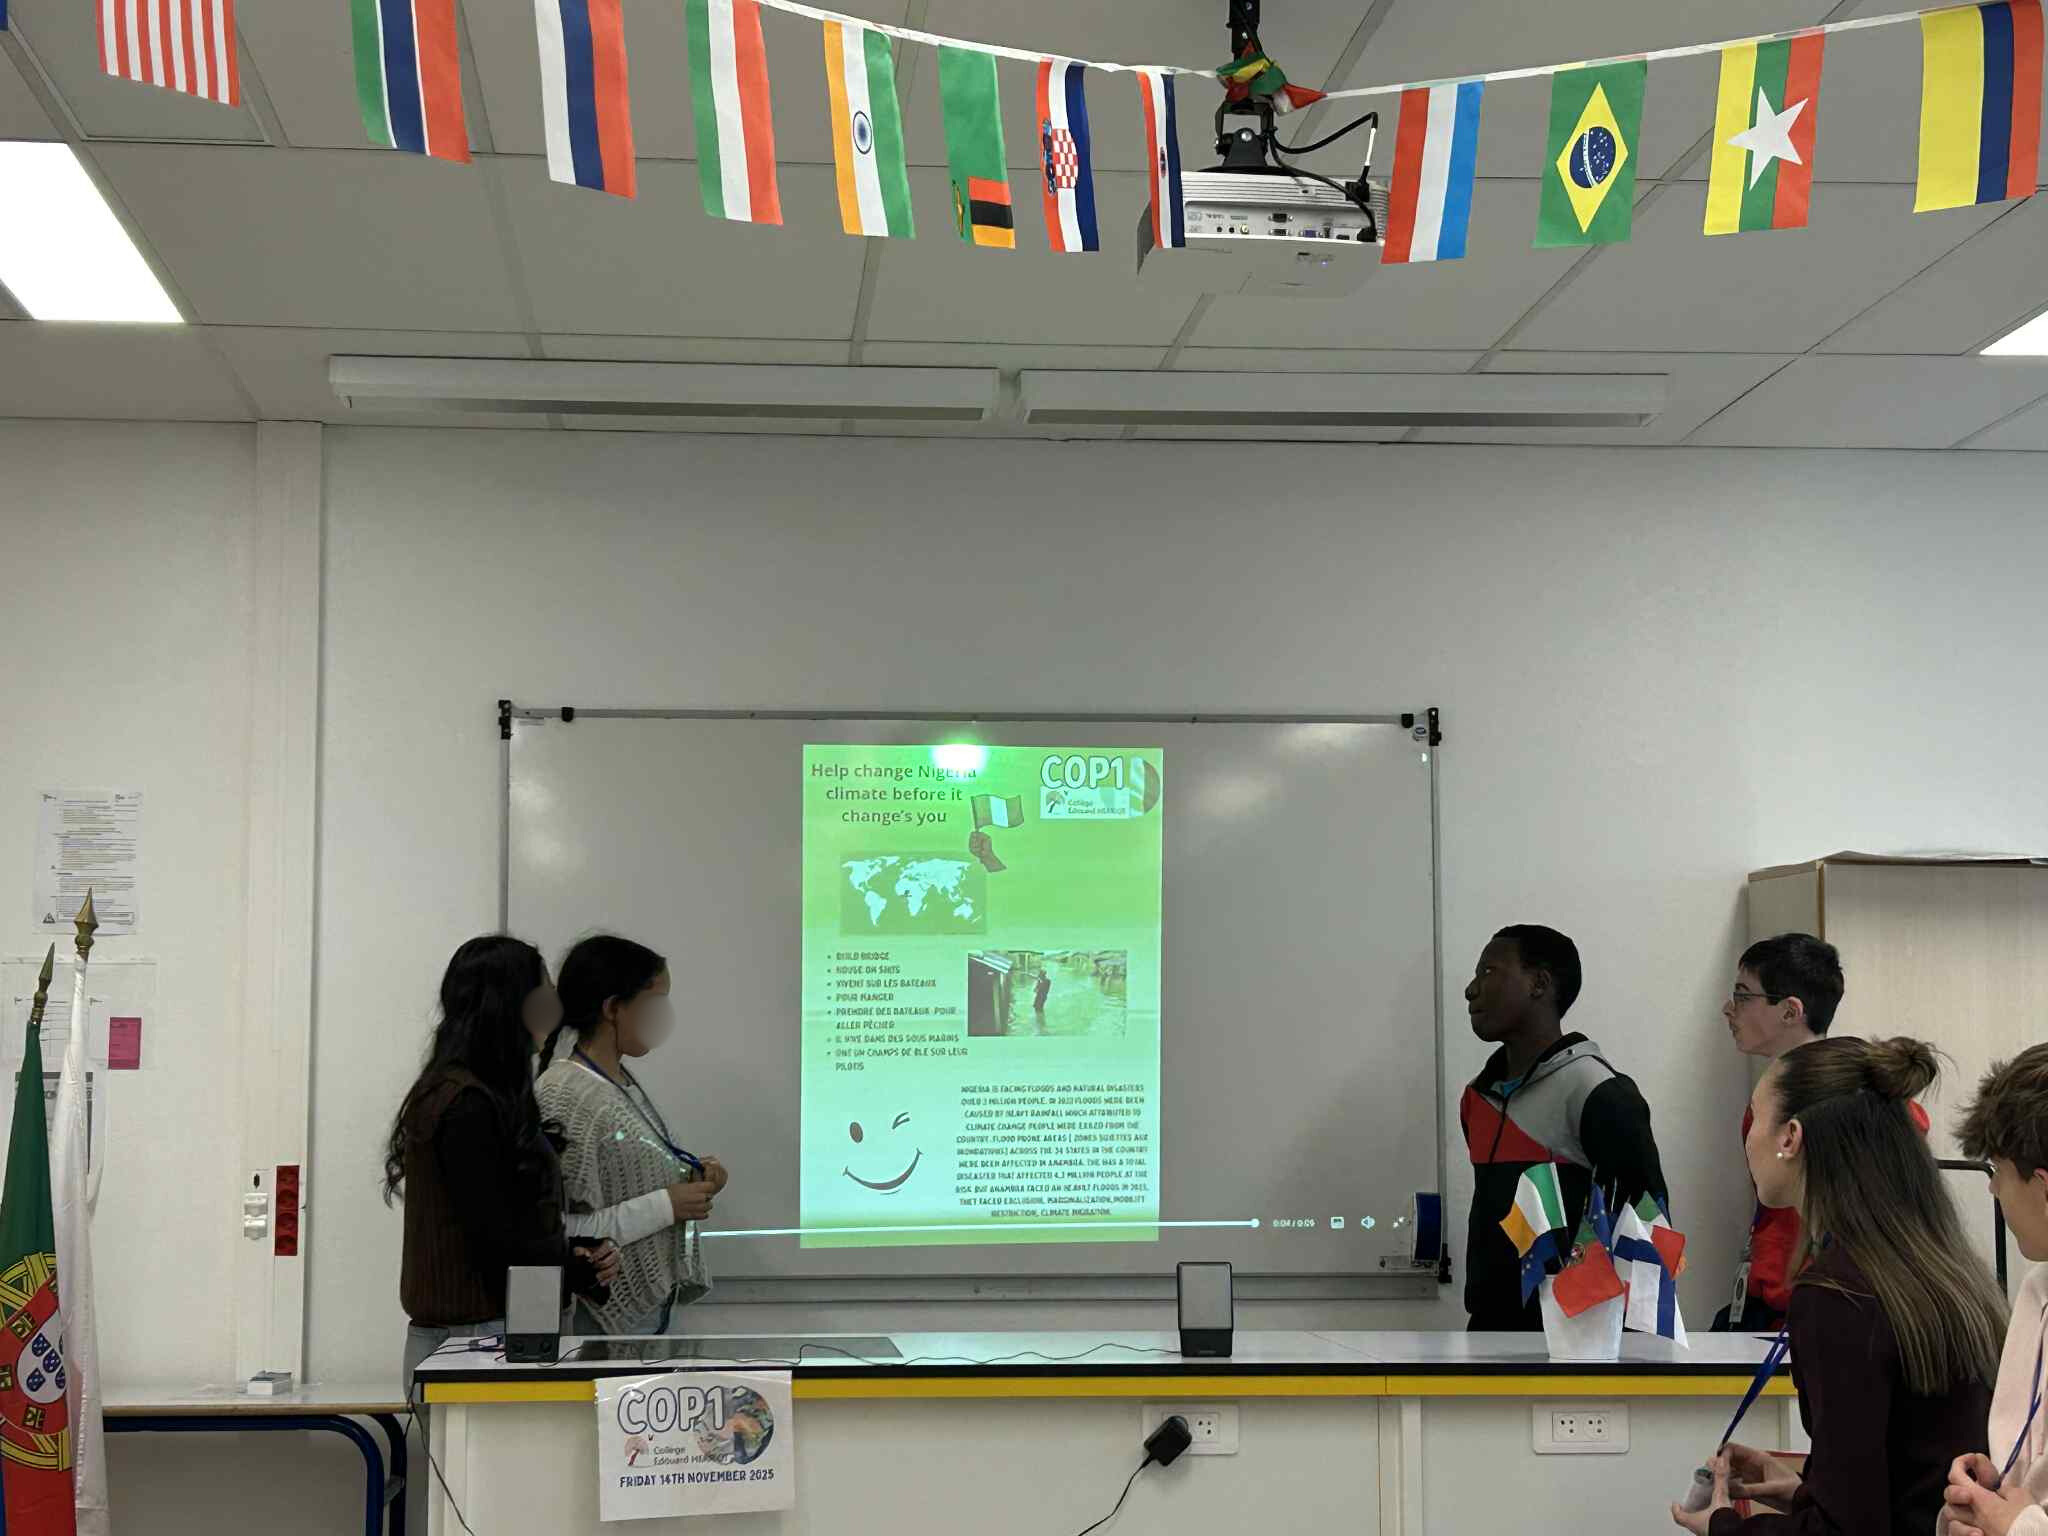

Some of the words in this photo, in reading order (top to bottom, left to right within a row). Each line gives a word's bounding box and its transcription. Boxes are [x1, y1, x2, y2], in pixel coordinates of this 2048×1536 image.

[811, 764, 848, 778] Help
[854, 764, 913, 781] change
[1040, 755, 1125, 789] COP1
[826, 787, 888, 801] climate
[893, 787, 946, 801] before
[951, 787, 962, 801] it
[842, 810, 912, 826] change's
[917, 812, 947, 825] you
[884, 980, 898, 988] LES
[617, 1385, 725, 1435] COP1
[620, 1475, 656, 1488] FRIDAY
[660, 1473, 685, 1485] 14TH
[687, 1470, 746, 1484] NOVEMBER
[749, 1469, 775, 1481] 2025
